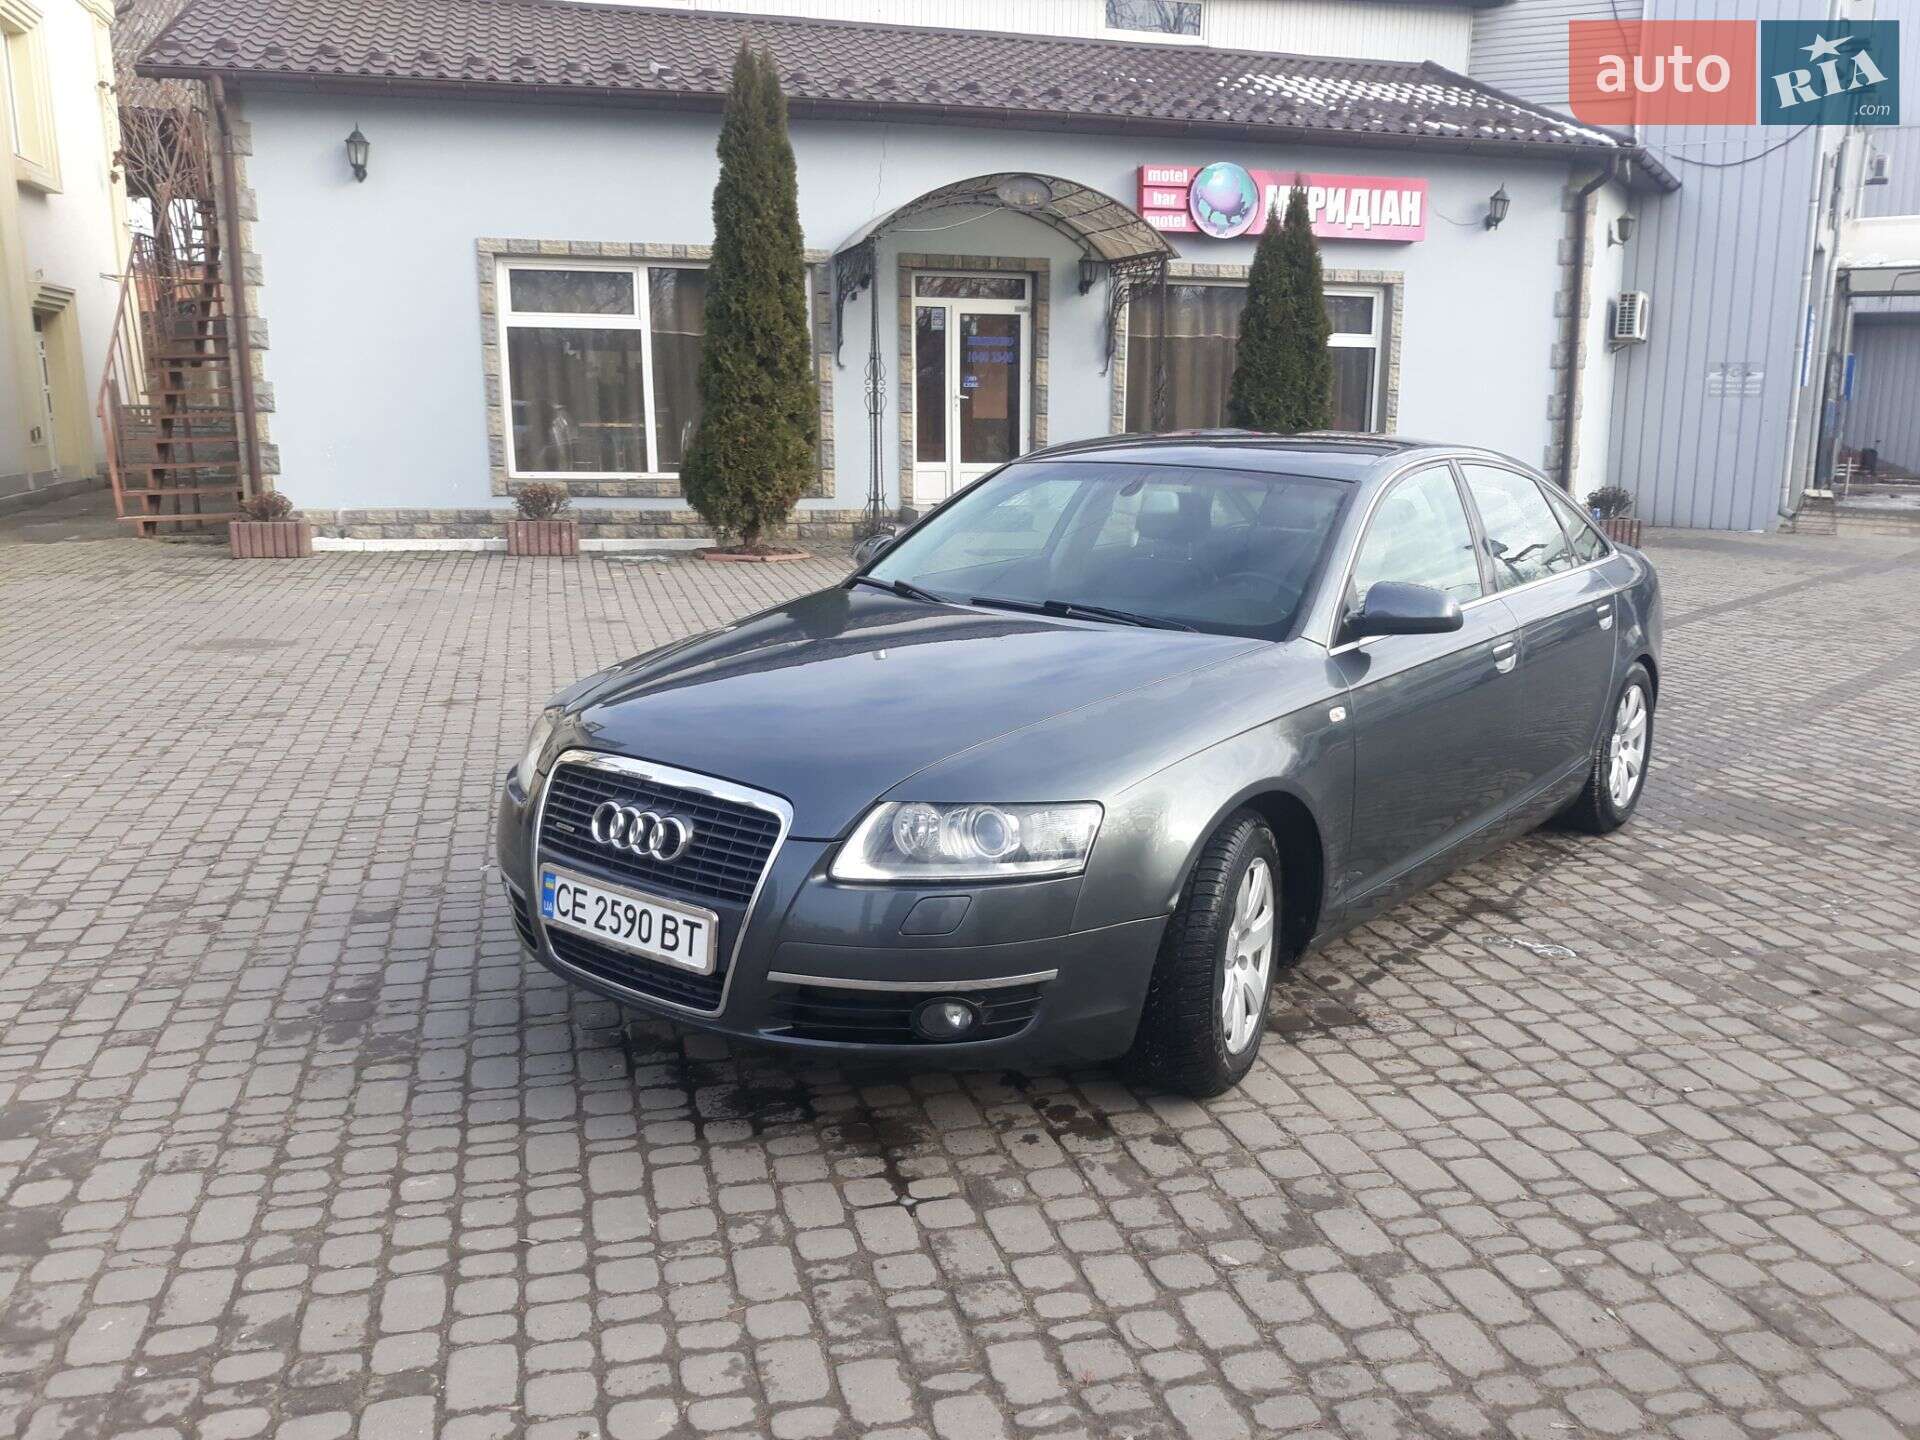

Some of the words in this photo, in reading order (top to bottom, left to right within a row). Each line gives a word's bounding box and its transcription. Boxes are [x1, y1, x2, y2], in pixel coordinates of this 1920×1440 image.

[1148, 169, 1187, 182] motel
[1153, 191, 1177, 205] bar
[1265, 185, 1422, 230] МРИДІАН
[556, 883, 588, 925] CE
[594, 895, 653, 944] 2590
[660, 913, 702, 957] BT
